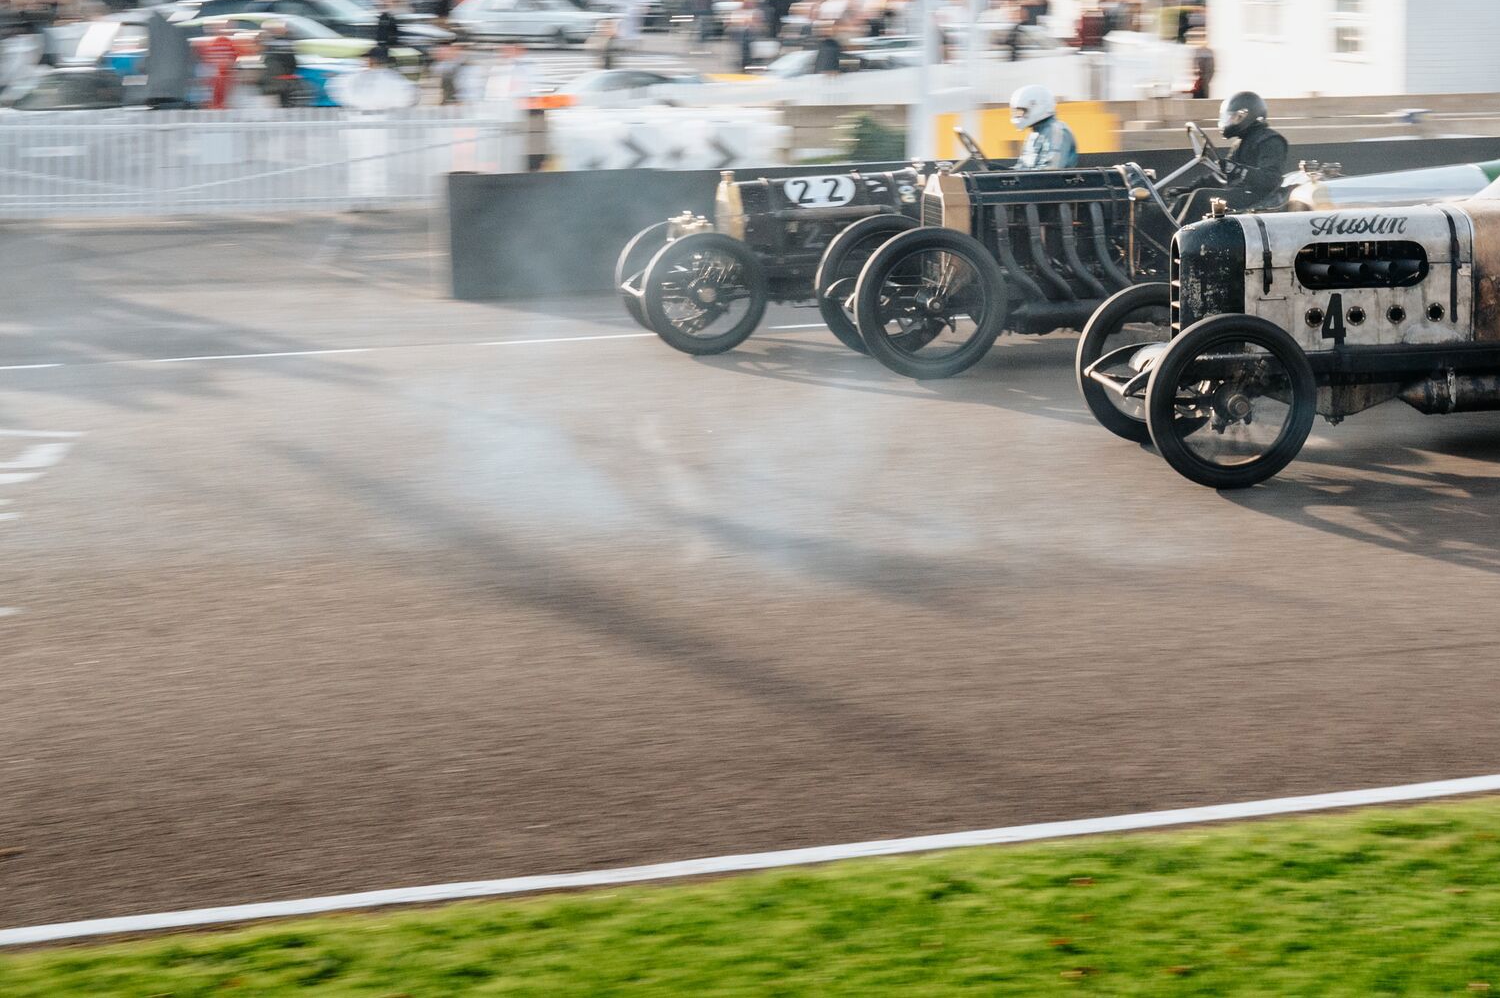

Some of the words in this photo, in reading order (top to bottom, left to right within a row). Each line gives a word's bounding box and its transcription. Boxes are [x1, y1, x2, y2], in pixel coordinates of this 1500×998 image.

[793, 178, 844, 203] 22
[1309, 212, 1408, 236] Austin
[1321, 293, 1346, 346] 4
